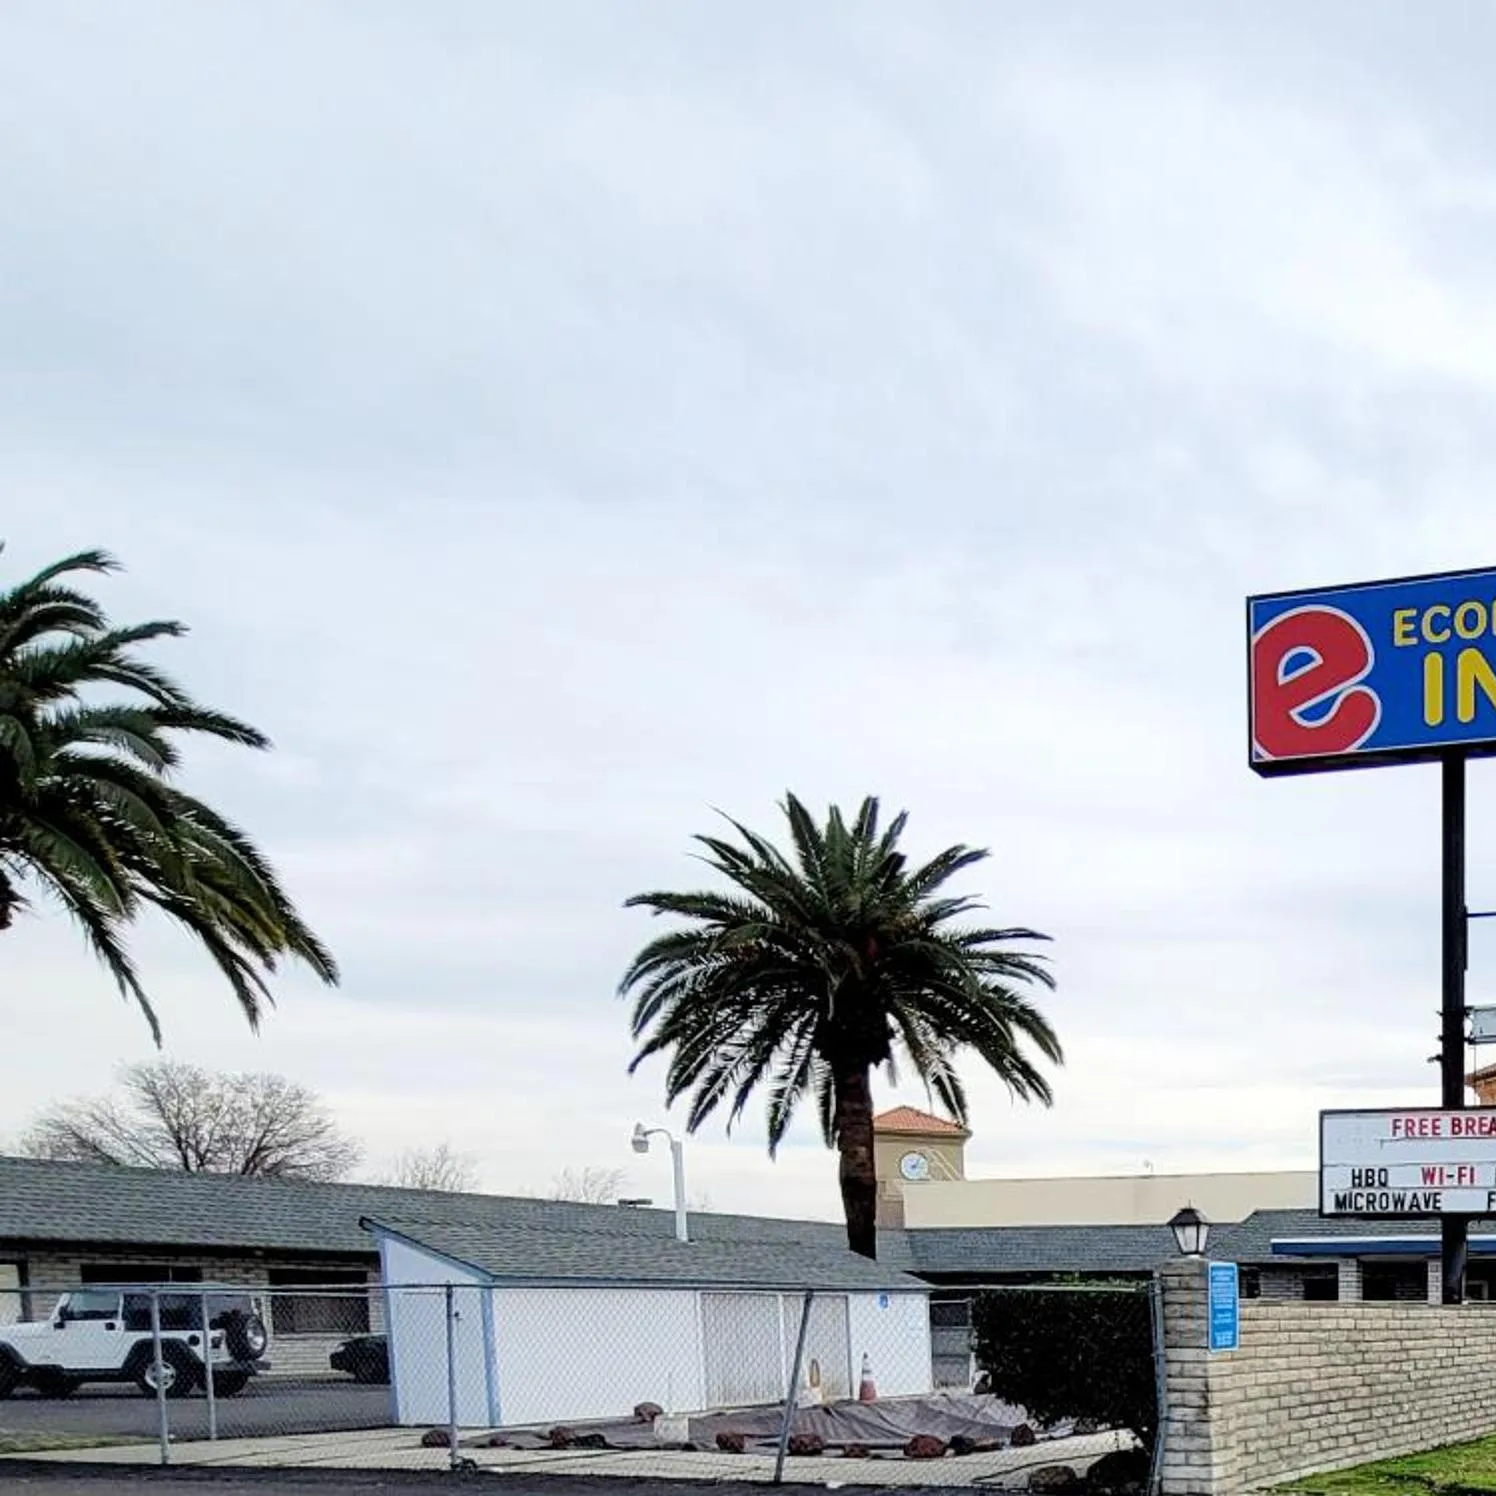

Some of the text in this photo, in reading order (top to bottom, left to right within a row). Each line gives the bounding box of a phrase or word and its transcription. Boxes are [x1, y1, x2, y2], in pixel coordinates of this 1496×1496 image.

[1391, 1117, 1442, 1137] FREE
[1351, 1168, 1389, 1188] HBO
[1421, 1166, 1475, 1185] WI-FI
[1334, 1191, 1442, 1212] MICROWAVE
